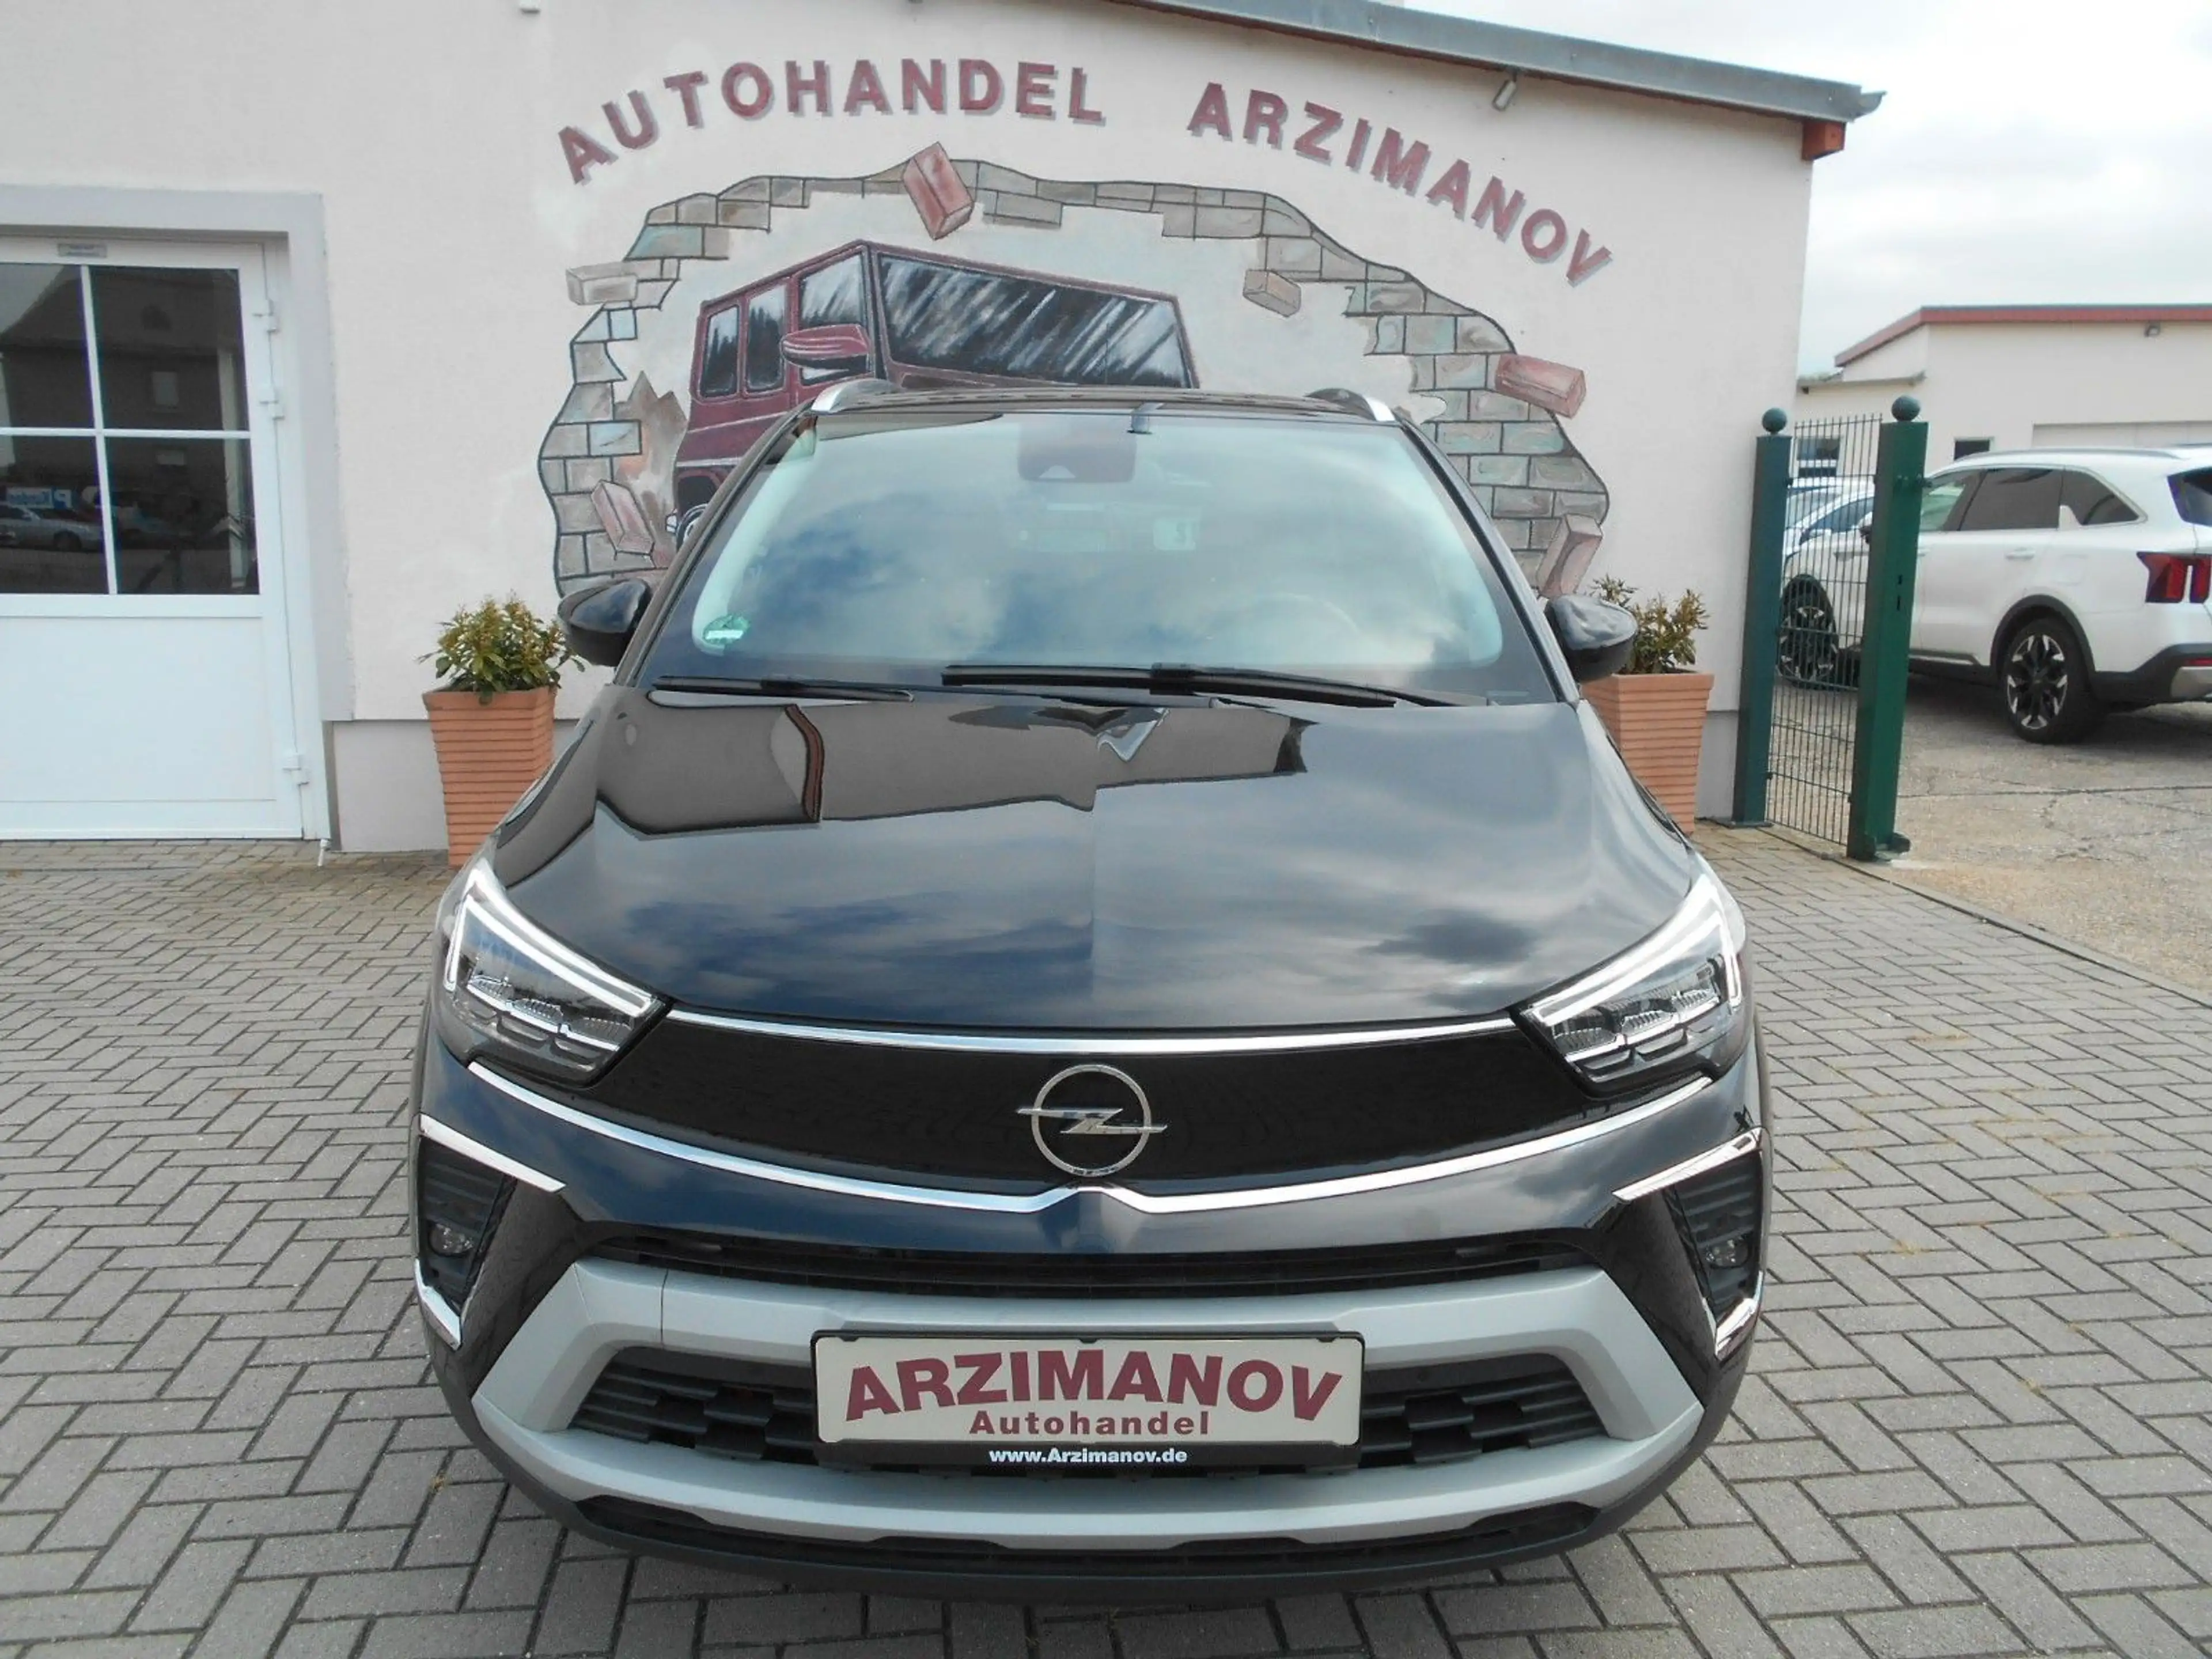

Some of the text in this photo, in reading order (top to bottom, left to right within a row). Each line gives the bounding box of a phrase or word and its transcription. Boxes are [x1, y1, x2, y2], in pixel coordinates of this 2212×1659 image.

[556, 58, 1612, 287] AUTOHANDEL ARZIMANOV
[845, 1349, 1343, 1422] ARZIMANOV
[969, 1410, 1209, 1435] Autohandel
[988, 1446, 1188, 1464] www.Arzimanov.de
